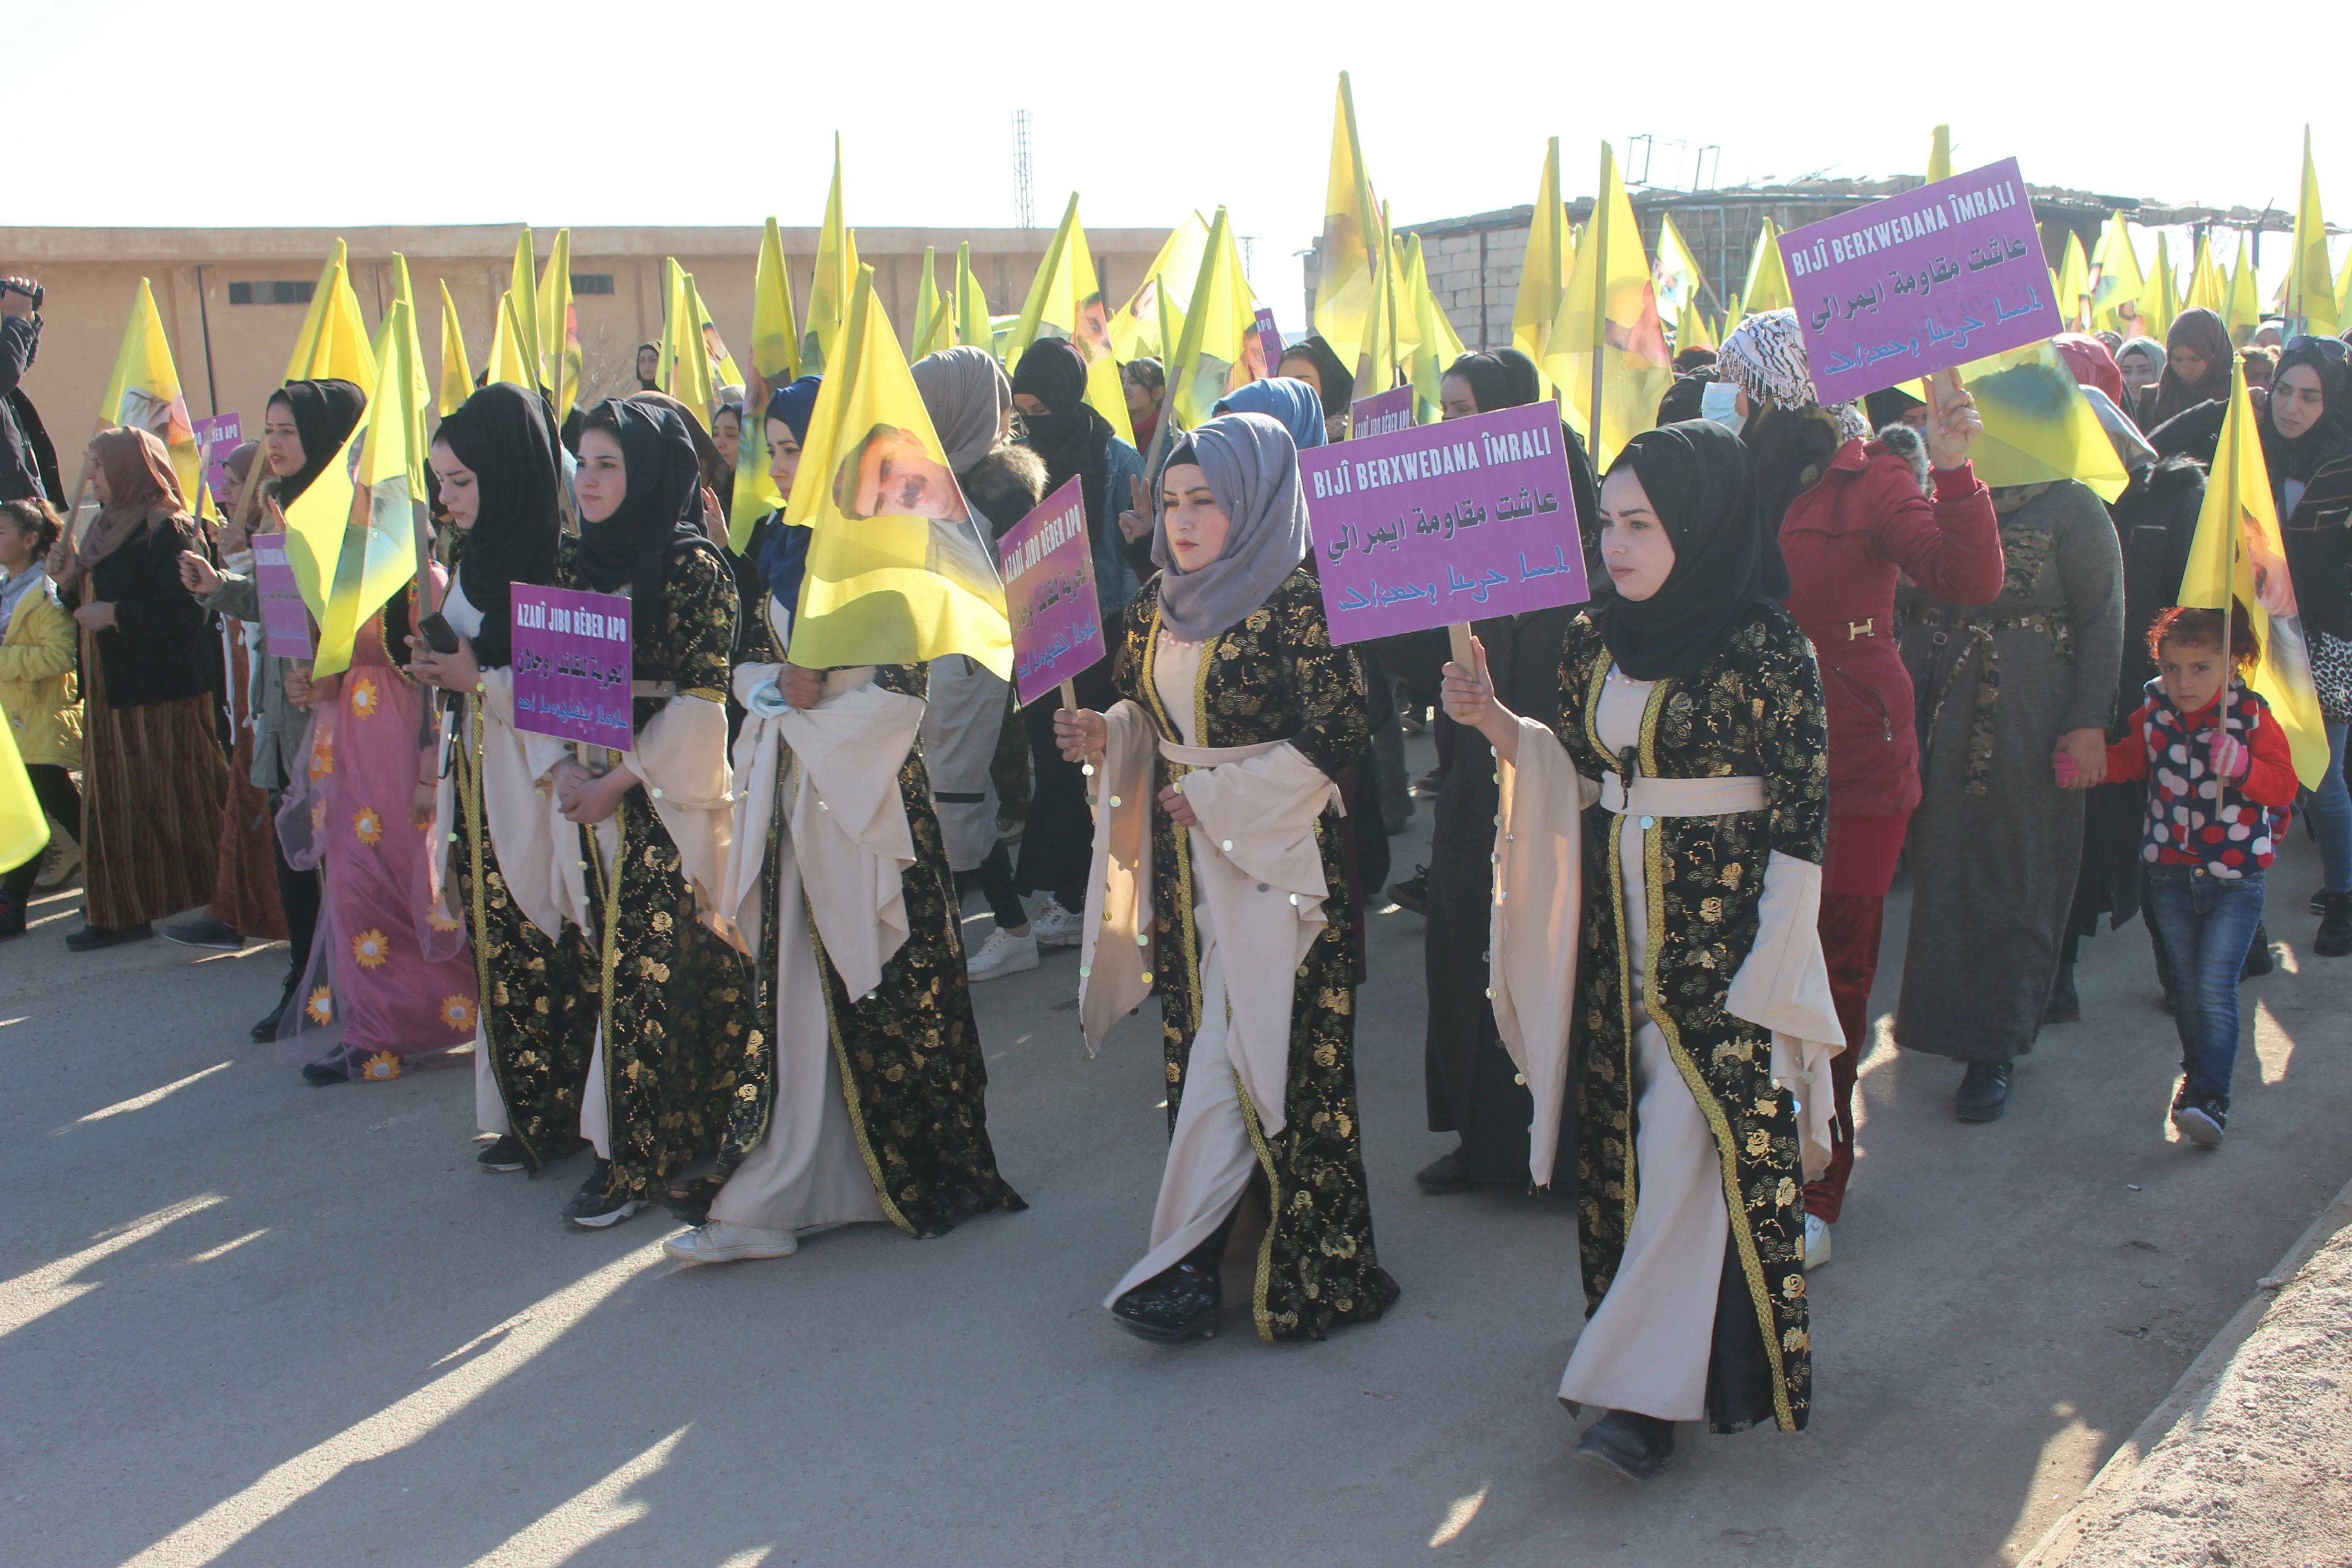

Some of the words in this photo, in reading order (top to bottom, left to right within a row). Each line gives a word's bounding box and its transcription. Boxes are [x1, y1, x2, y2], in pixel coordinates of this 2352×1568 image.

[1792, 239, 1829, 276] BIJÎ
[1832, 205, 1949, 264] BERXWEDANA
[1949, 181, 2016, 223] ÎMRALI
[1968, 236, 2027, 272] عاشت
[1888, 256, 1960, 296] مقاومة
[1256, 318, 1272, 332] APO
[1811, 280, 1884, 334] ايمرالي
[225, 424, 238, 440] APO
[1399, 409, 1409, 430] APO
[1313, 460, 1352, 499] BIJÎ
[1356, 441, 1480, 490] BERXWEDANA
[1481, 427, 1552, 466] ÎMRALI
[1411, 499, 1487, 539] مقاومة
[1495, 486, 1559, 522] عاشت
[1004, 541, 1024, 584] AZADÎ
[1024, 535, 1041, 569] JIBO
[1042, 517, 1064, 557] RÊBER
[1065, 505, 1081, 540] APO
[1328, 513, 1406, 566] ايمرالي
[517, 601, 546, 630] AZADÎ
[549, 607, 571, 634] JIBO
[573, 606, 604, 639] RÊBER
[607, 615, 626, 642] APO
[590, 656, 627, 690] الحرية
